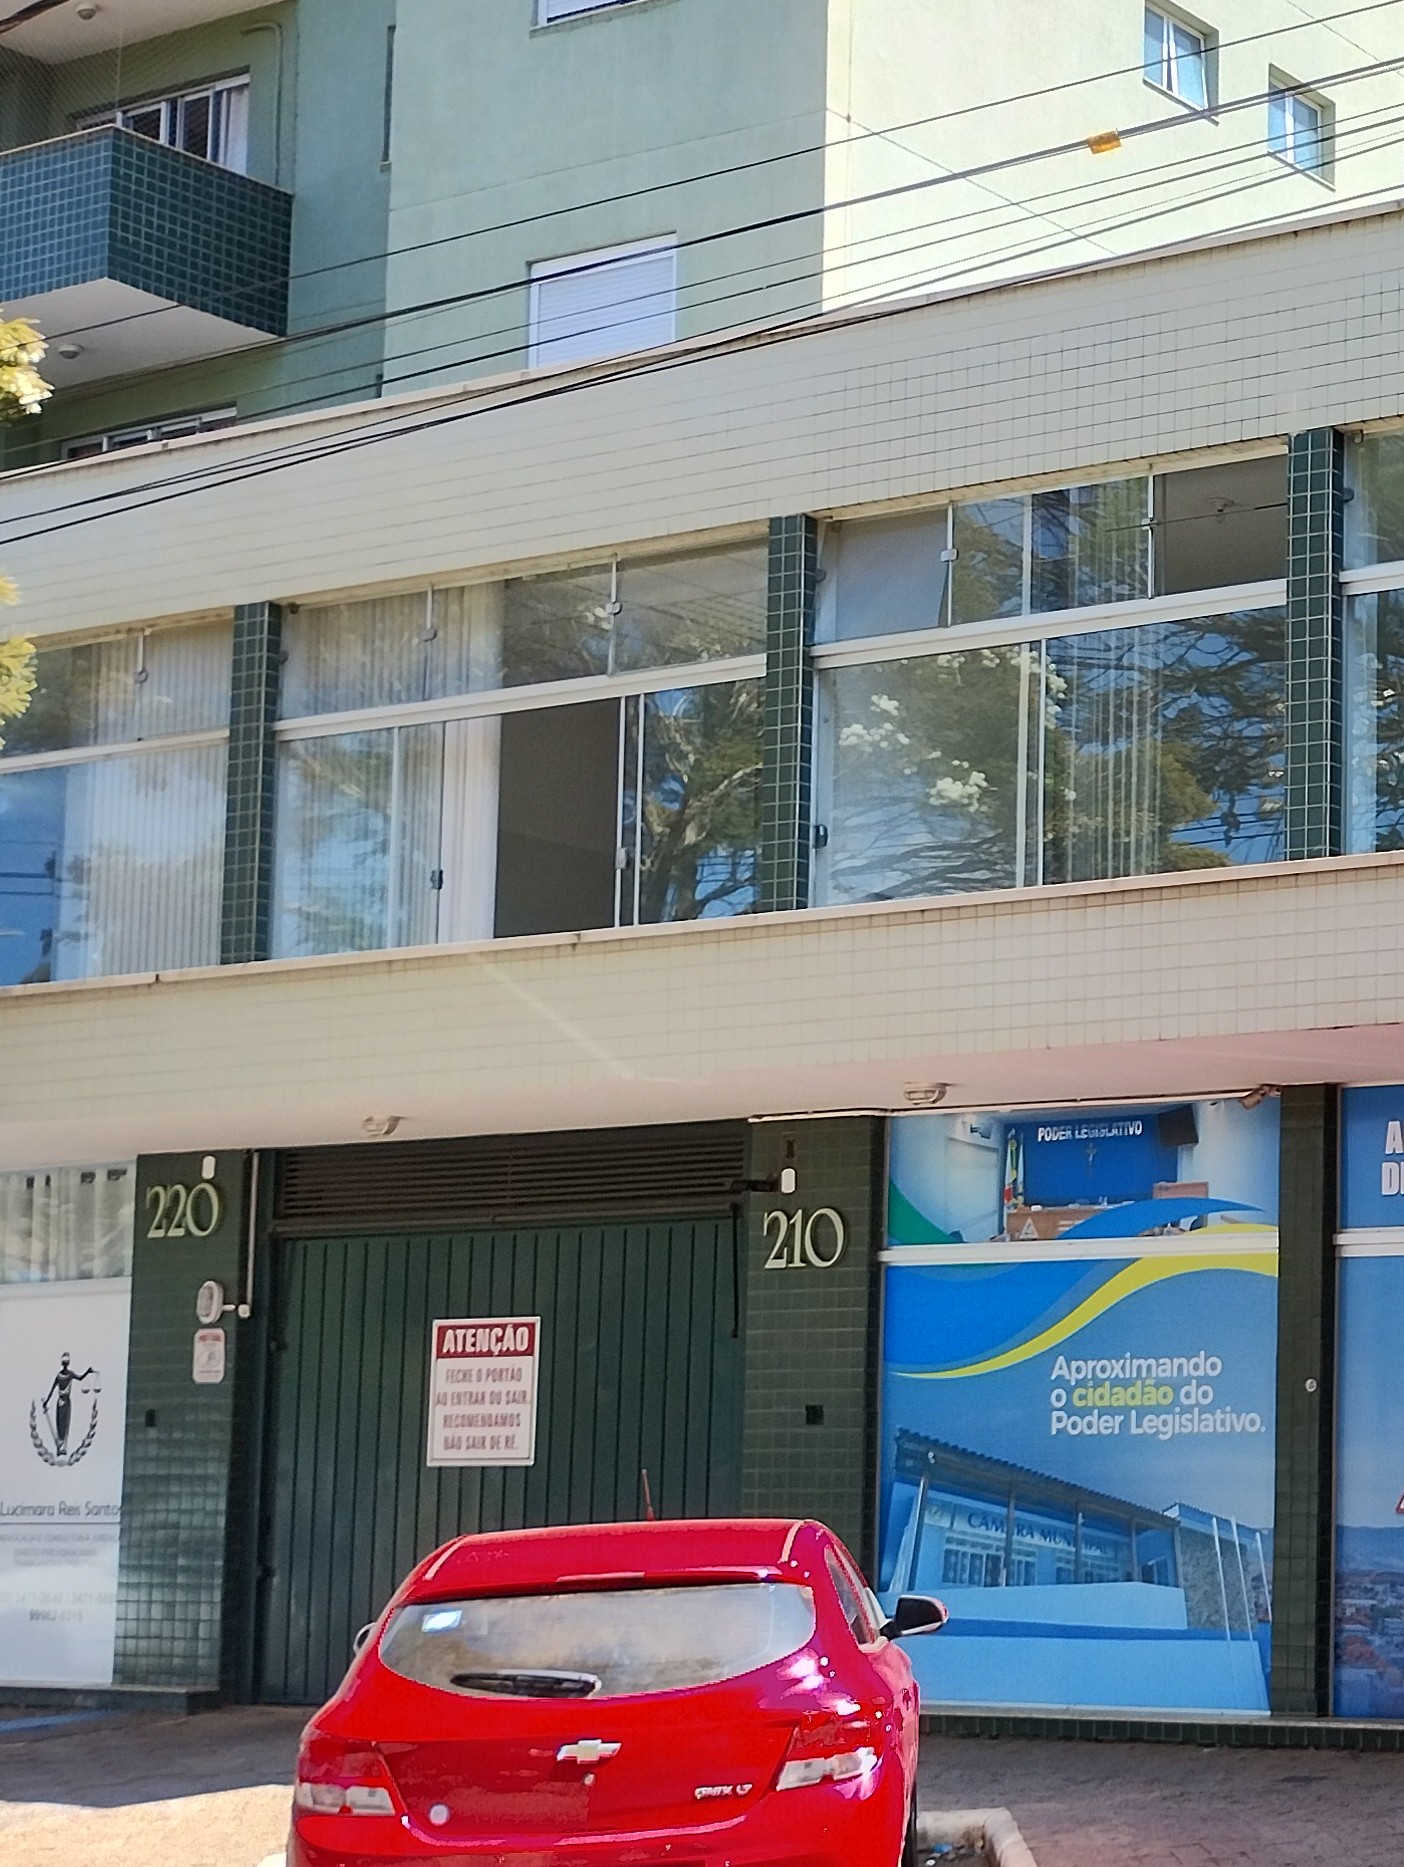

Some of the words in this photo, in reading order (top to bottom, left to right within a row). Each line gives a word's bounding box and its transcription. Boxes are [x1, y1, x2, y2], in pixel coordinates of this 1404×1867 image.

[1038, 1126, 1072, 1142] PODER
[1074, 1120, 1143, 1139] LEGISLATIVO
[145, 1182, 219, 1238] 220
[763, 1207, 844, 1269] 210
[442, 1323, 530, 1356] ATENÇÃO
[445, 1367, 473, 1383] FECHE
[476, 1367, 483, 1383] O
[486, 1364, 522, 1383] PORTÃO
[1051, 1351, 1223, 1386] Aproximando
[436, 1391, 448, 1406] AO
[451, 1391, 485, 1405] ENTRAR
[489, 1390, 502, 1405] OU
[1050, 1388, 1067, 1408] o
[1073, 1379, 1175, 1407] cidadão
[1180, 1379, 1213, 1405] do
[443, 1413, 521, 1429] RECOMENDAMOS
[1051, 1408, 1124, 1435] Poder
[1130, 1405, 1266, 1441] Legislativo.
[465, 1434, 487, 1450] SAIR
[490, 1434, 501, 1450] DE
[0, 1500, 55, 1516] Lucimara
